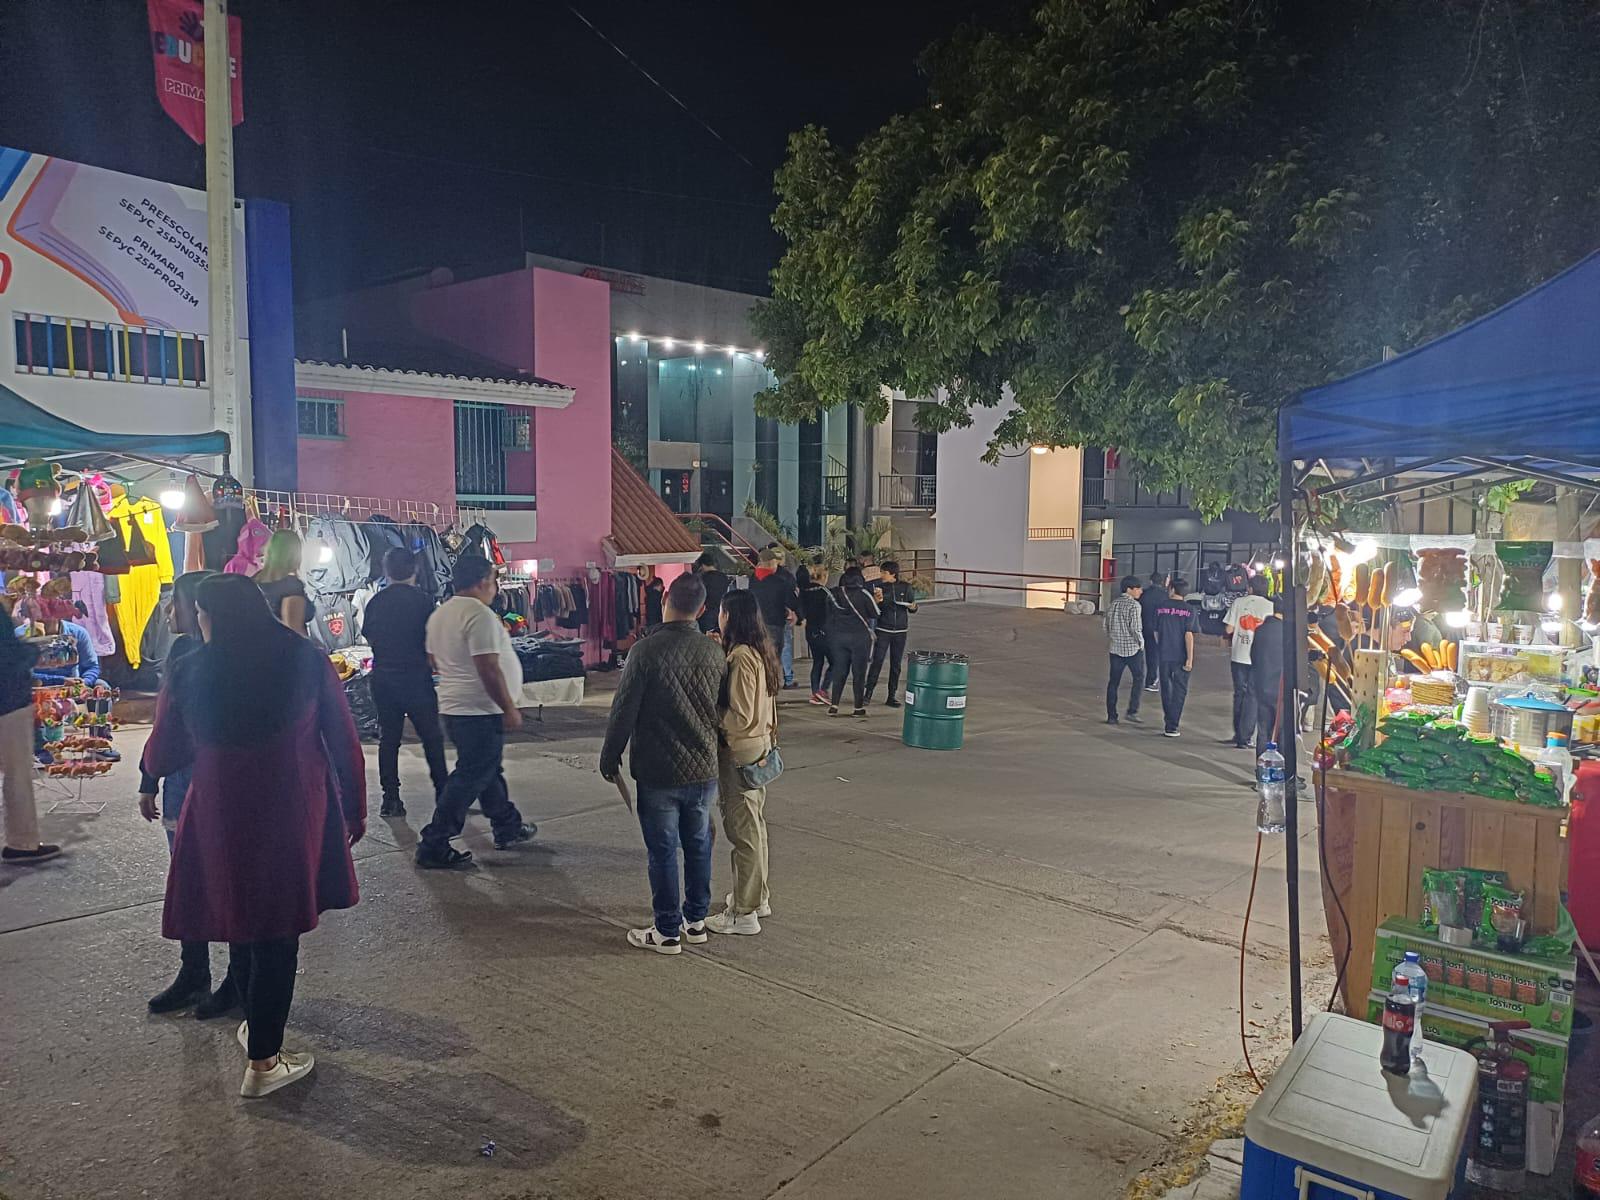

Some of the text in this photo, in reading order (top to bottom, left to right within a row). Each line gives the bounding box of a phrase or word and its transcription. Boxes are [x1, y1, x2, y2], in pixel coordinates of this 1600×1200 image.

[119, 198, 156, 229] SEPyC
[140, 198, 209, 257] PREESCOLAR
[98, 225, 135, 256] SEPyC
[133, 235, 184, 281] PRIMARIA
